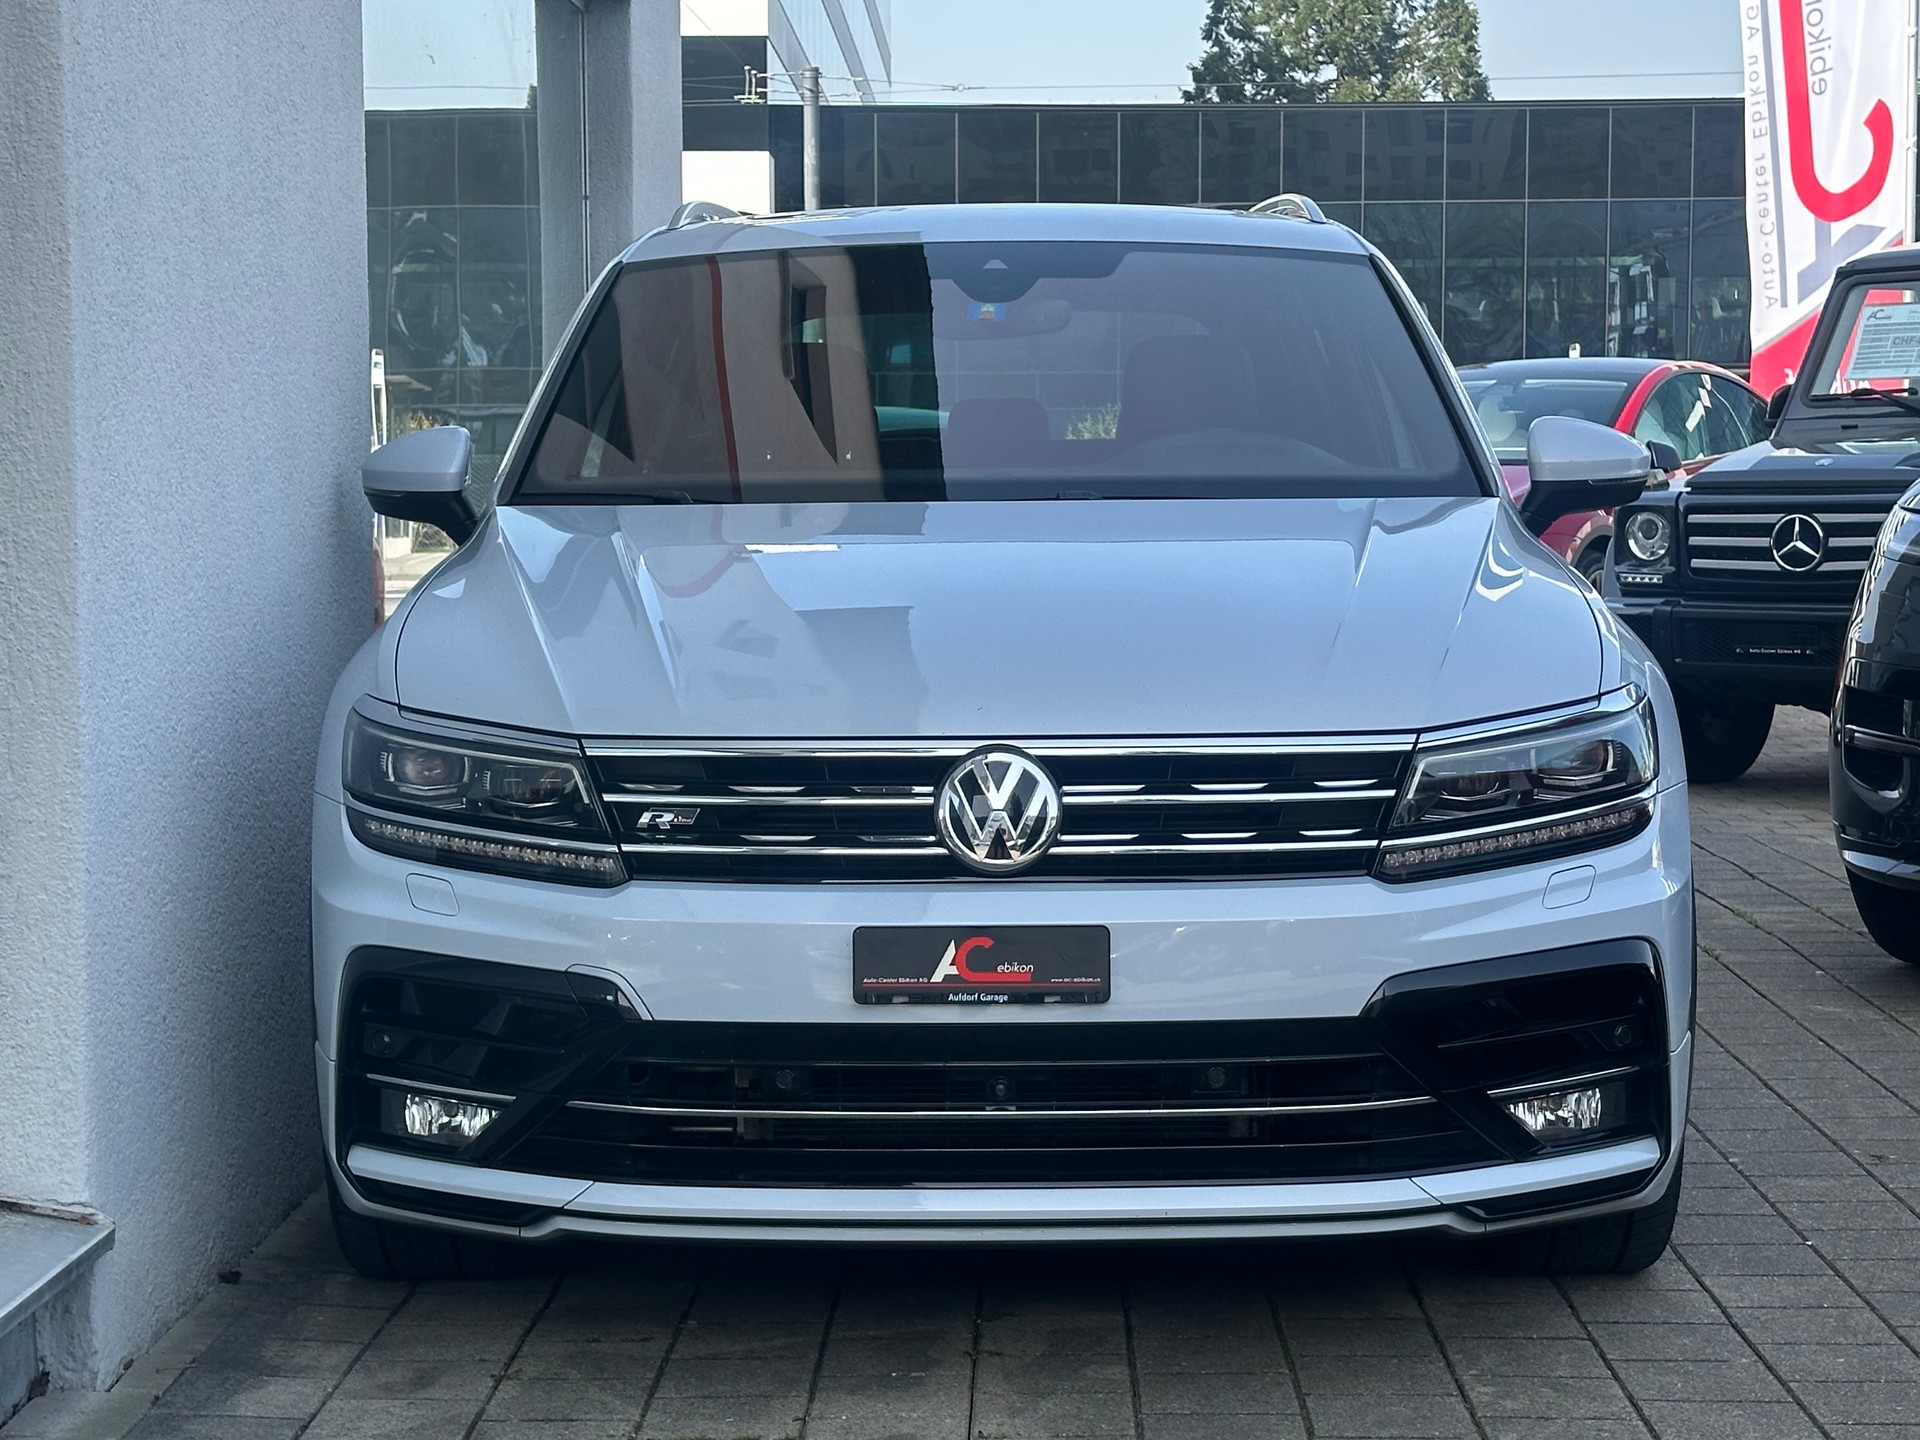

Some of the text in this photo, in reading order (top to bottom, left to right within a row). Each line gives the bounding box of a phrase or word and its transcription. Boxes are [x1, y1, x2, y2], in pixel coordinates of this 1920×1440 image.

[996, 961, 1034, 973] ebikon
[948, 992, 1008, 1003] Aufdorf Garage
